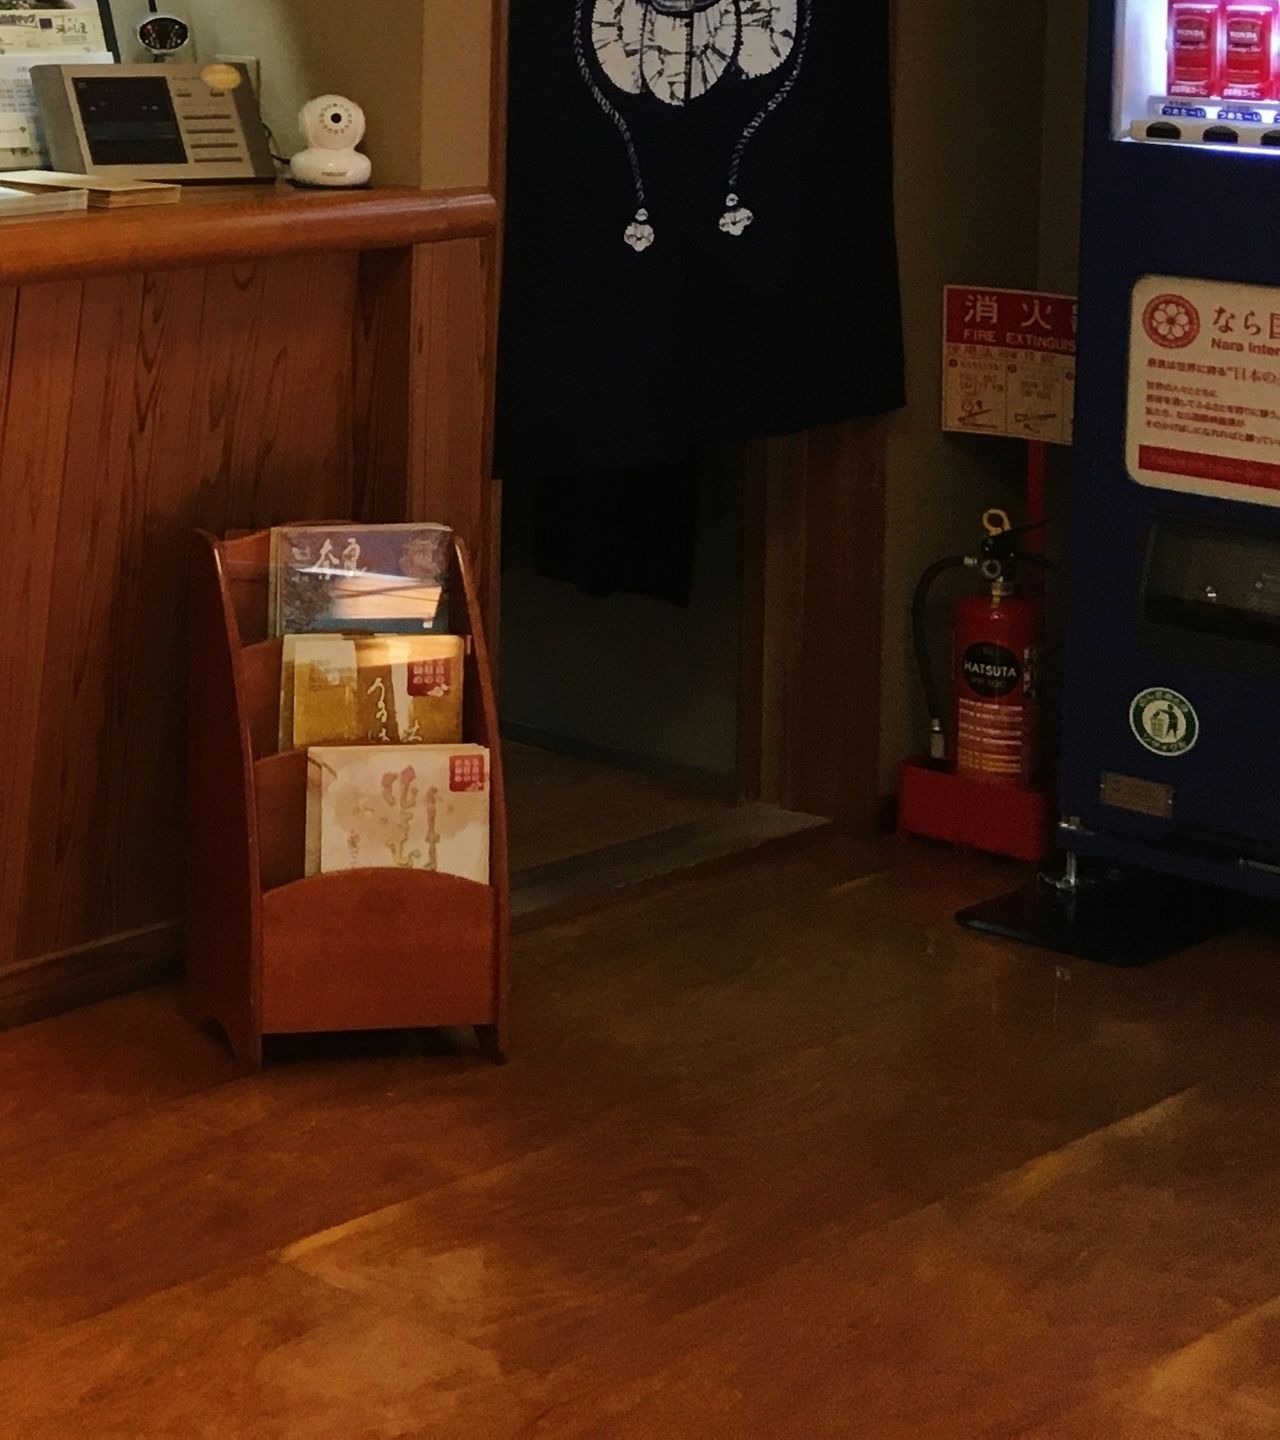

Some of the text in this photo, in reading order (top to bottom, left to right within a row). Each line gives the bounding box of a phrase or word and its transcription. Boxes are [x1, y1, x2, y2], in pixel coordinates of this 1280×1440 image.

[963, 293, 1078, 333] 消火
[963, 328, 997, 343] FIRE
[1211, 337, 1245, 353] Nara
[963, 660, 1017, 678] HATSUTA
